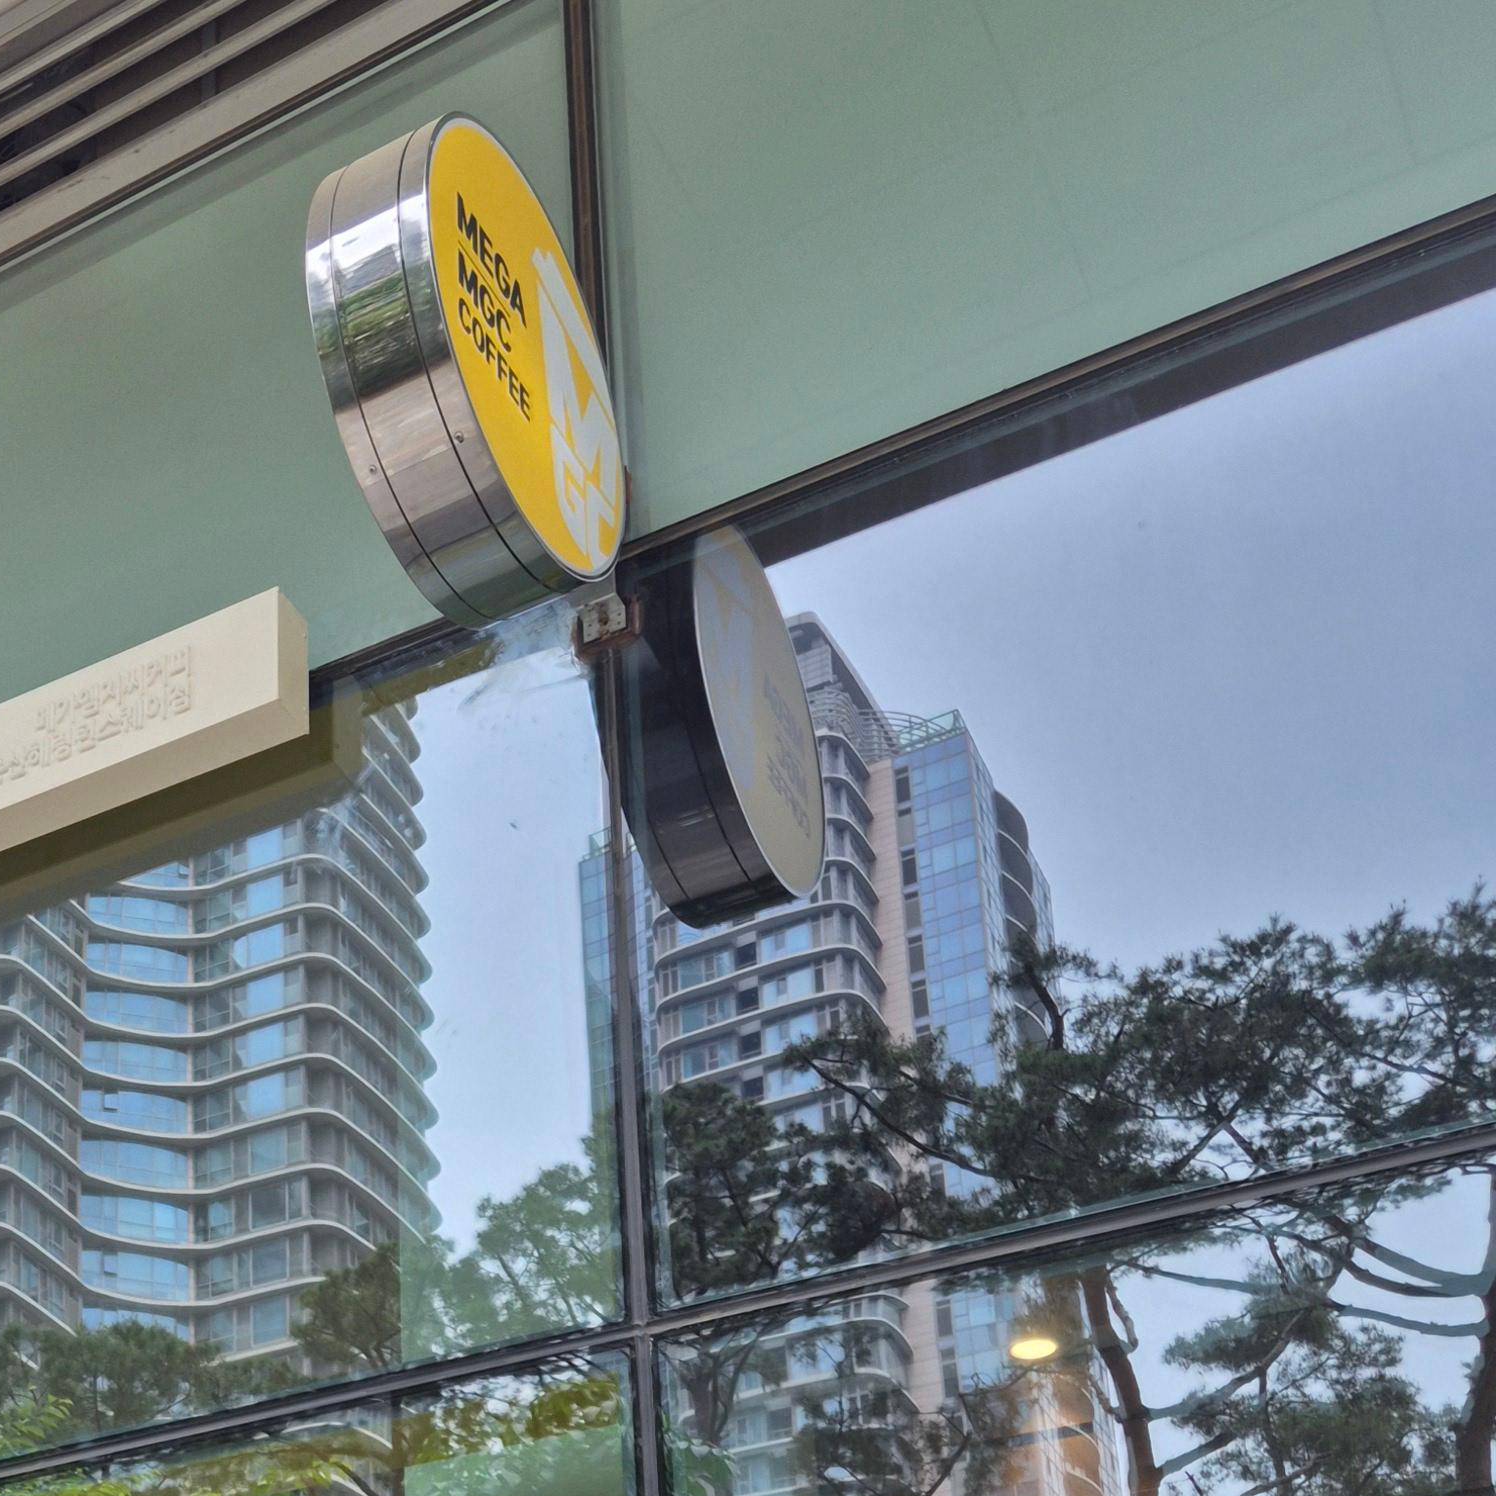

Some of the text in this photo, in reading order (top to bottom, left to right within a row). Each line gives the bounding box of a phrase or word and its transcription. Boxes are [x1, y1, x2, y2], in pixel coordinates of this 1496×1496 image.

[456, 191, 528, 328] MEGA
[456, 249, 512, 353] MGC
[456, 296, 532, 423] COFFEE
